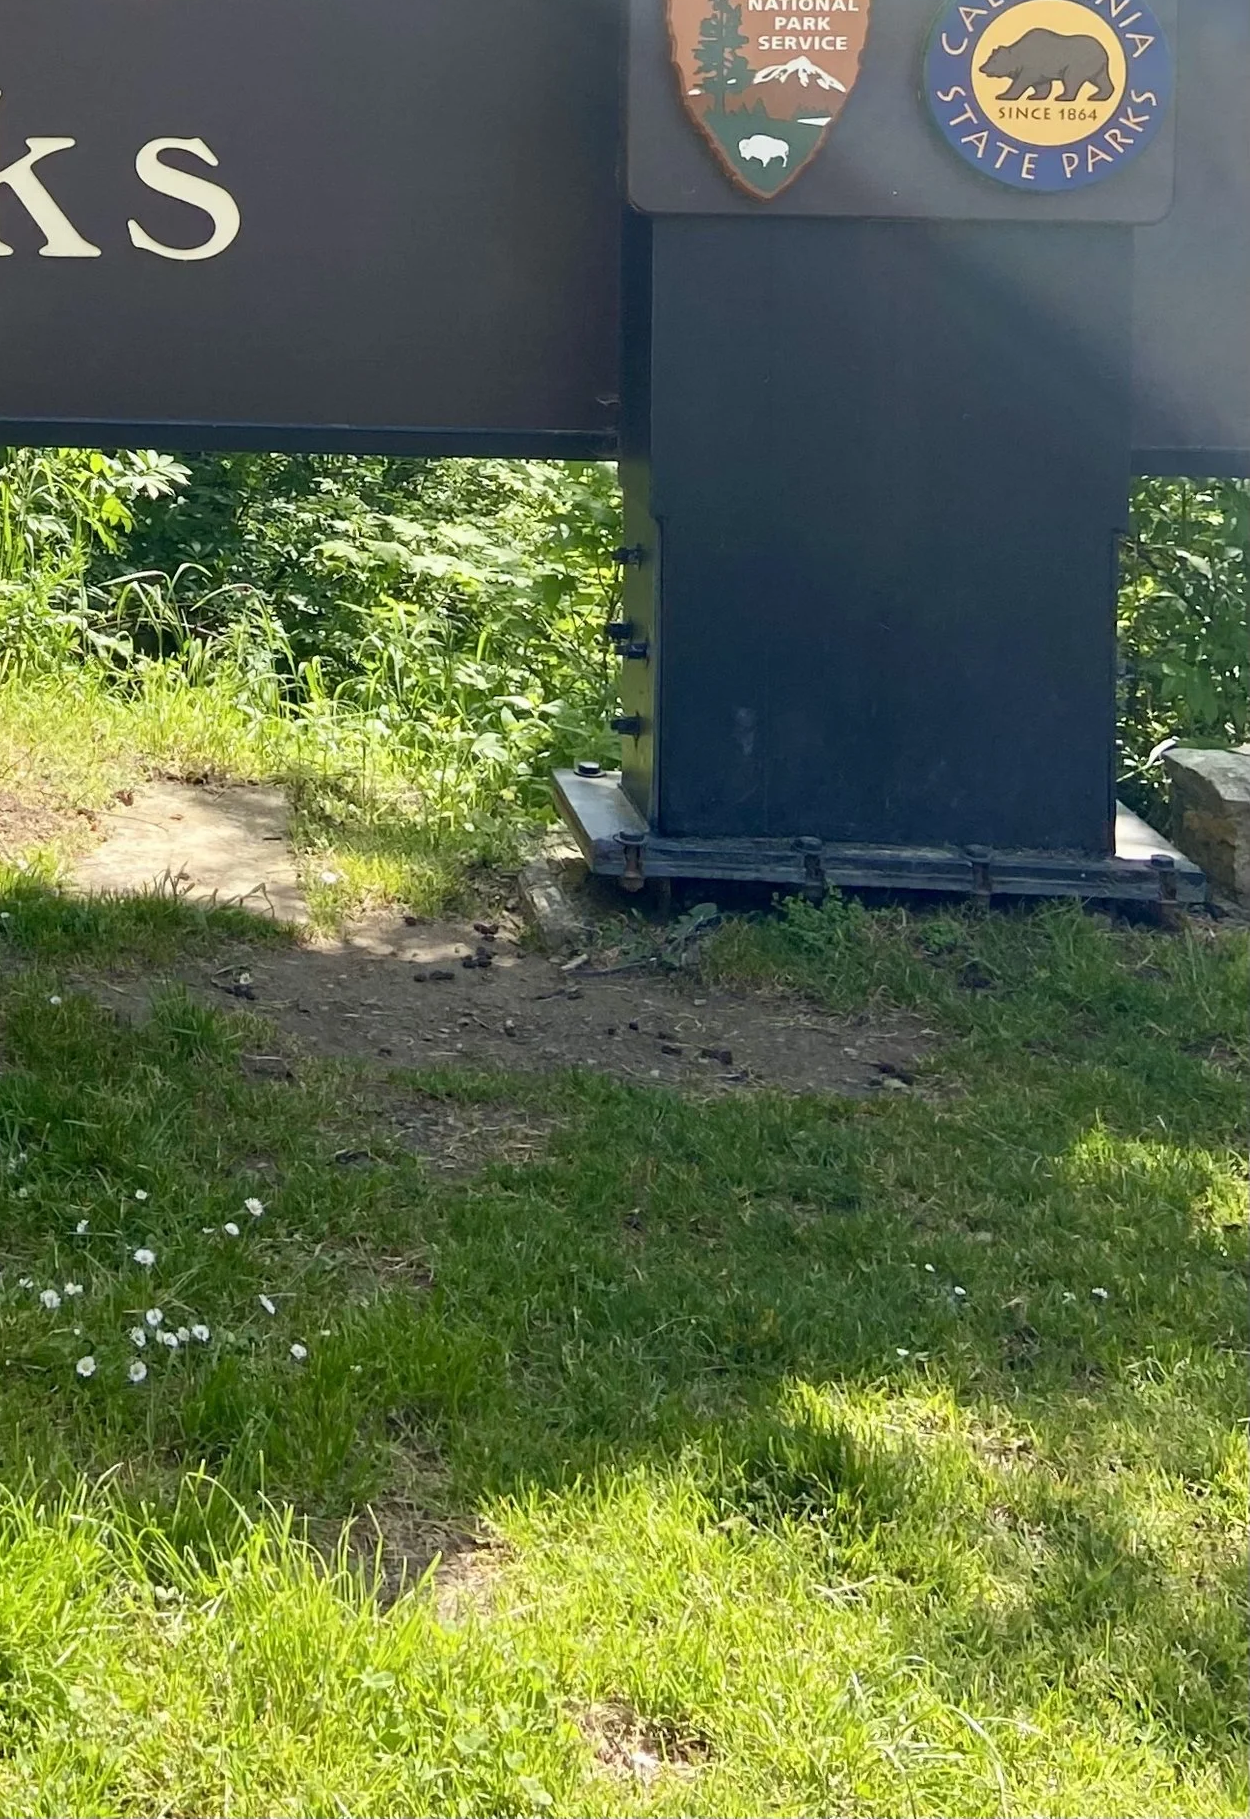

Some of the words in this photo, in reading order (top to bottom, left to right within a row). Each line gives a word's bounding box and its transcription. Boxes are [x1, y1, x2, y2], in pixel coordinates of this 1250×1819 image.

[774, 16, 831, 31] PARK
[757, 35, 848, 51] SERVICE
[998, 106, 1051, 121] SINCE
[1058, 107, 1098, 122] 1864
[936, 85, 1039, 180] STATE
[1061, 89, 1157, 179] PARKS
